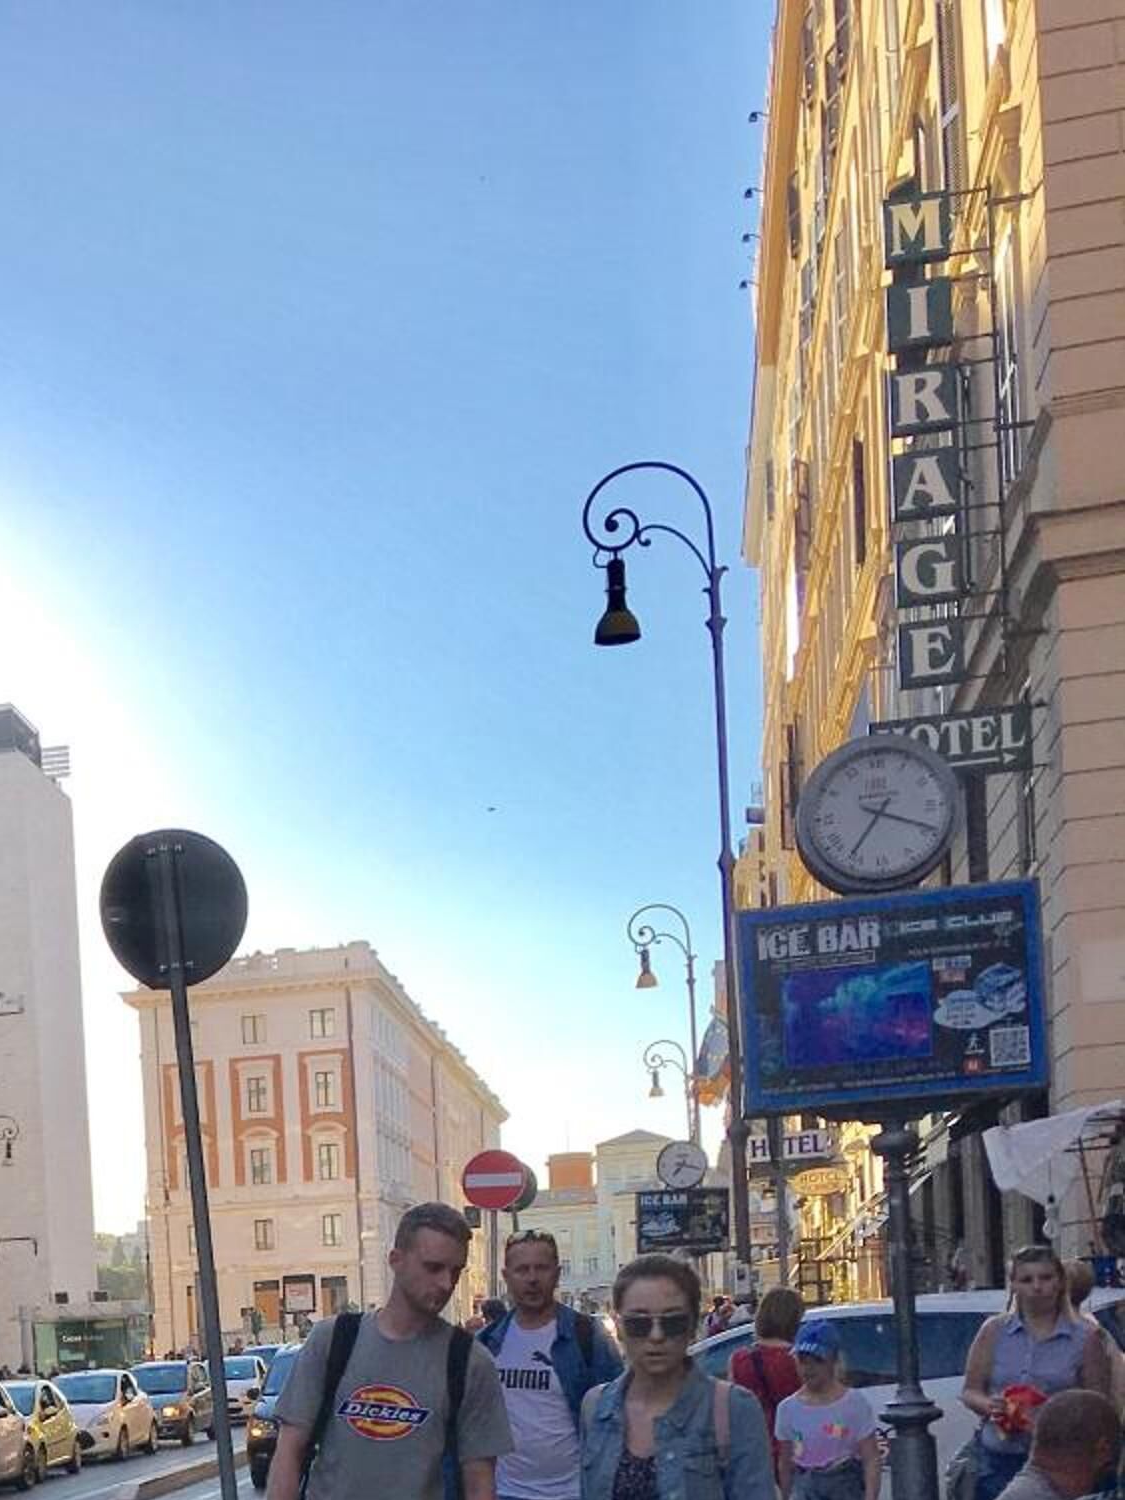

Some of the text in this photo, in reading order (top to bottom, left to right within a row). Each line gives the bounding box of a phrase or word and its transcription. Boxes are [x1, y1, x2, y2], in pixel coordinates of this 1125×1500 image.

[888, 199, 956, 678] MIRAGE
[877, 713, 1025, 756] OTEL
[758, 927, 810, 961] ICE
[817, 915, 880, 954] BAR
[752, 1134, 824, 1158] HTEL
[343, 1401, 423, 1422] Dickies
